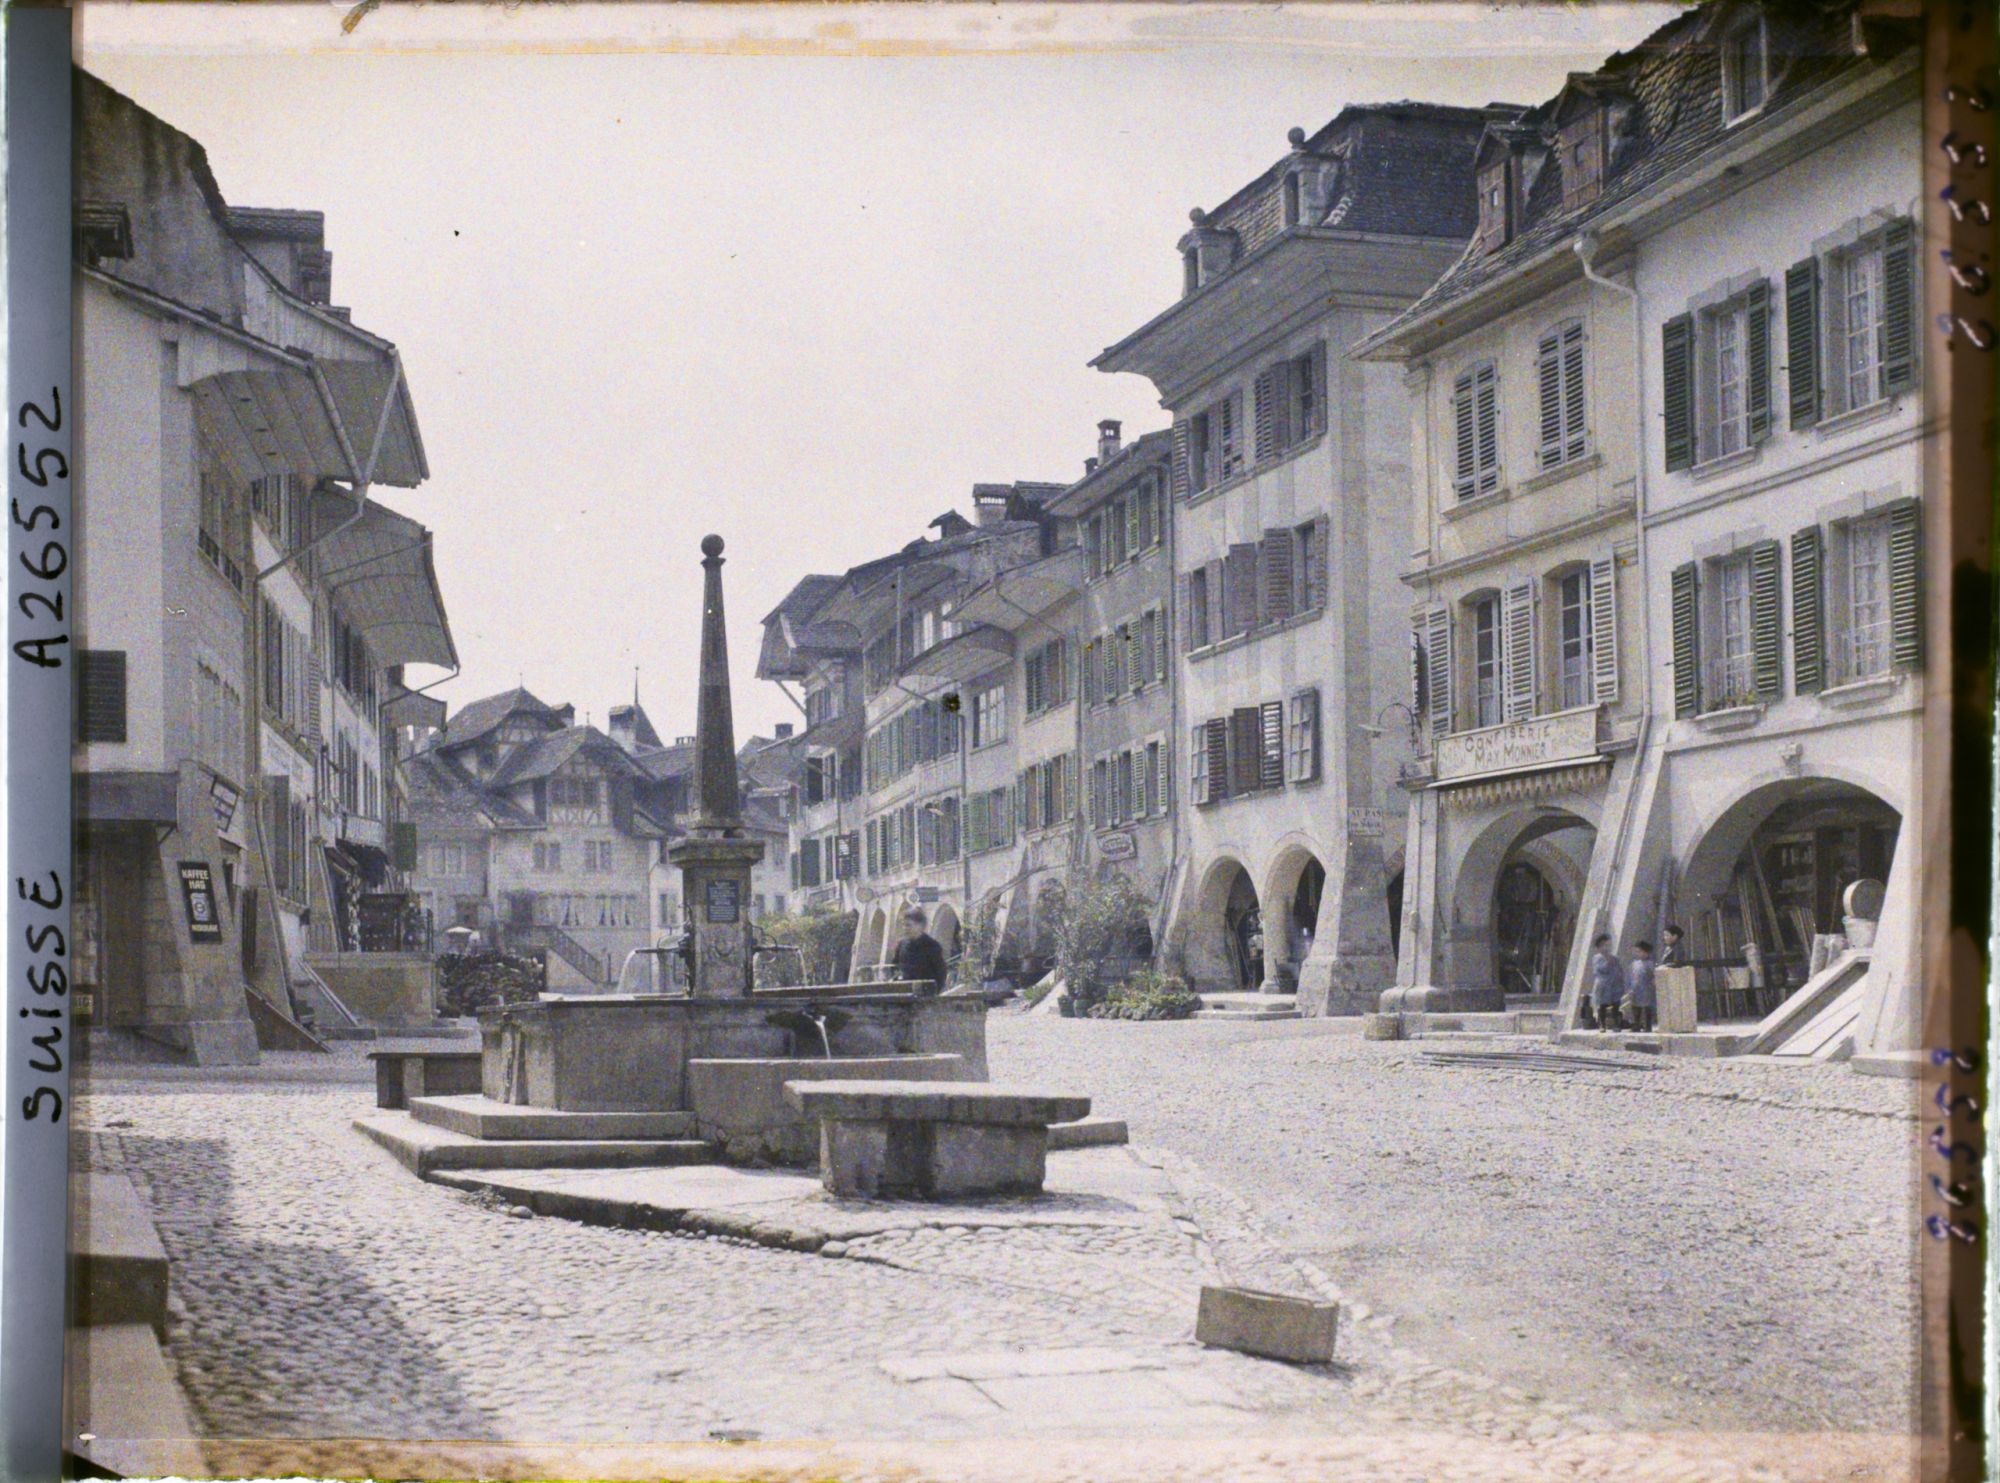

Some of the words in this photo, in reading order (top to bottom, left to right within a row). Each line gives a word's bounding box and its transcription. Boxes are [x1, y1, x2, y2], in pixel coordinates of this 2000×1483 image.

[14, 386, 67, 668] A26552
[1465, 725, 1550, 752] CONFISERIE
[182, 869, 209, 880] KAFFEE
